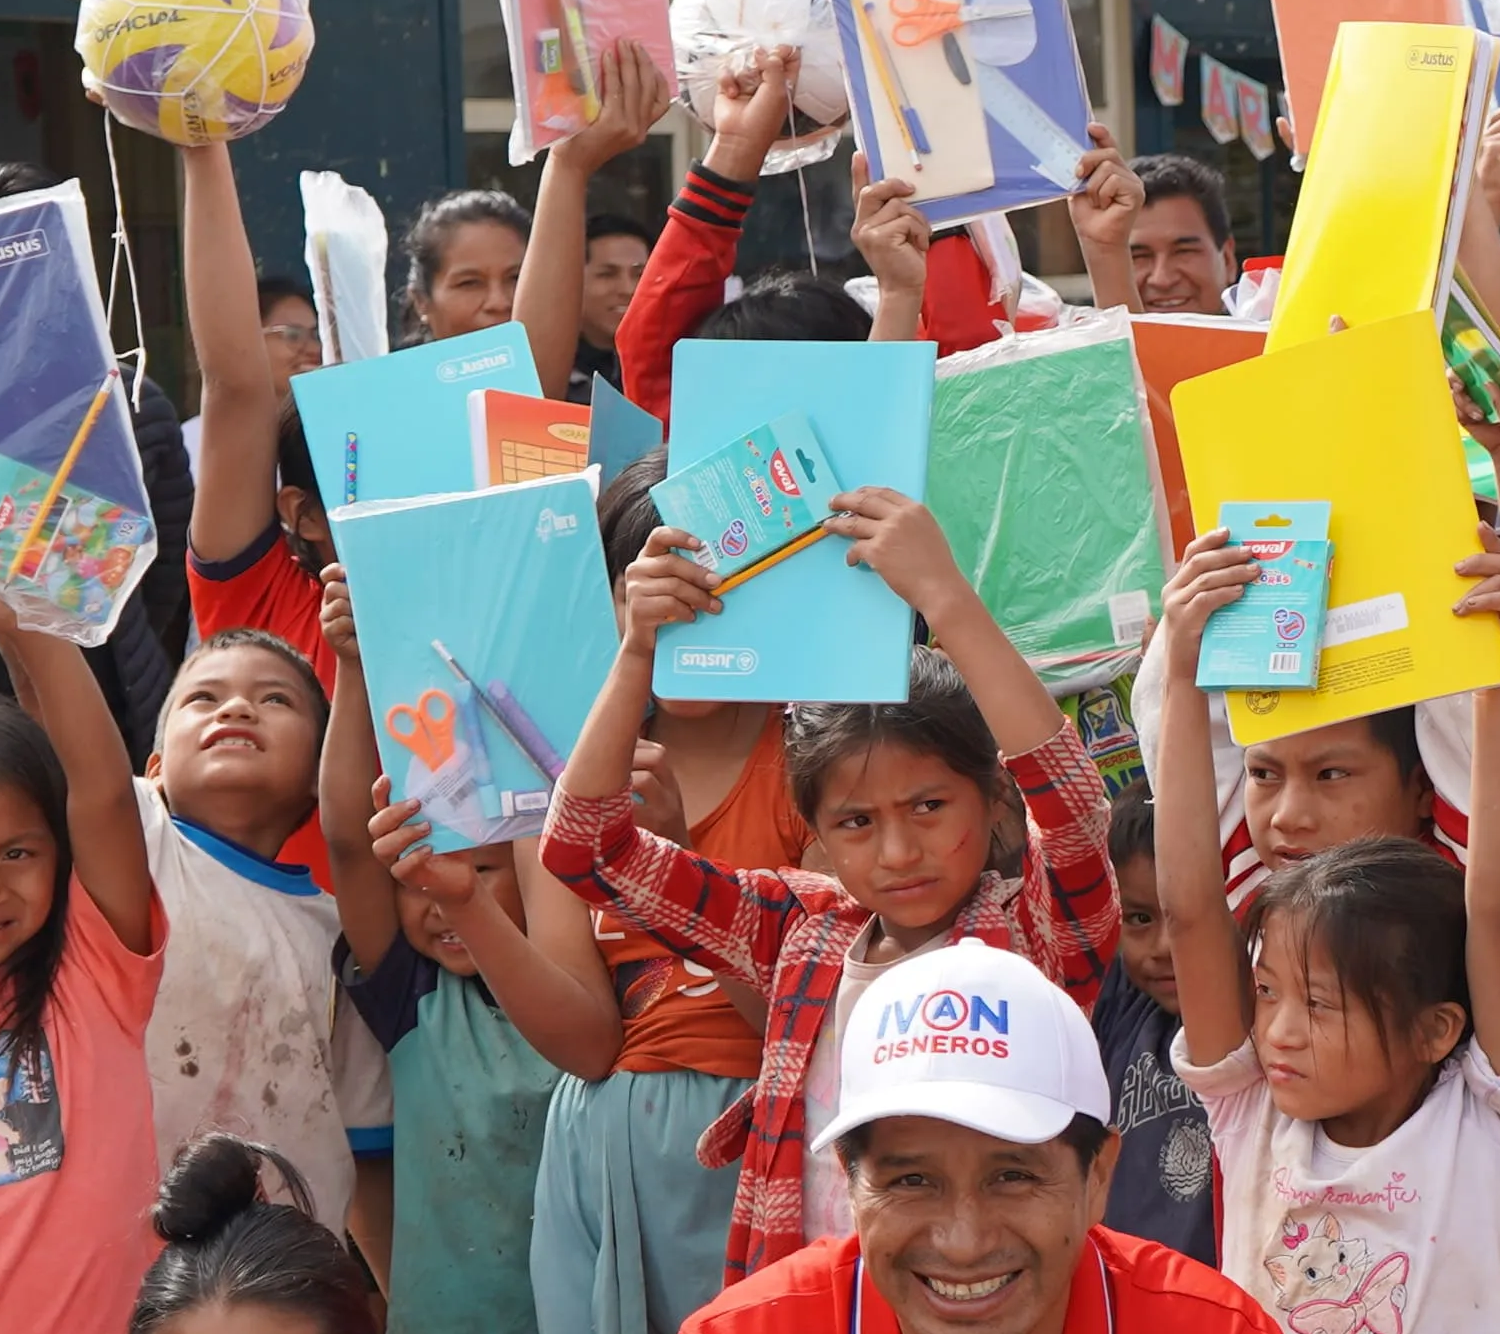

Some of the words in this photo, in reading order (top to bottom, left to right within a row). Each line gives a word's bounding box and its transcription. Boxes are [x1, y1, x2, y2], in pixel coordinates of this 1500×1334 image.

[1420, 51, 1454, 66] Justus
[459, 352, 509, 375] Justus
[773, 459, 797, 492] oval
[1251, 541, 1285, 554] oval
[680, 652, 735, 669] Justus
[876, 992, 1009, 1040] IVAN
[873, 1034, 1009, 1065] CISNEROS
